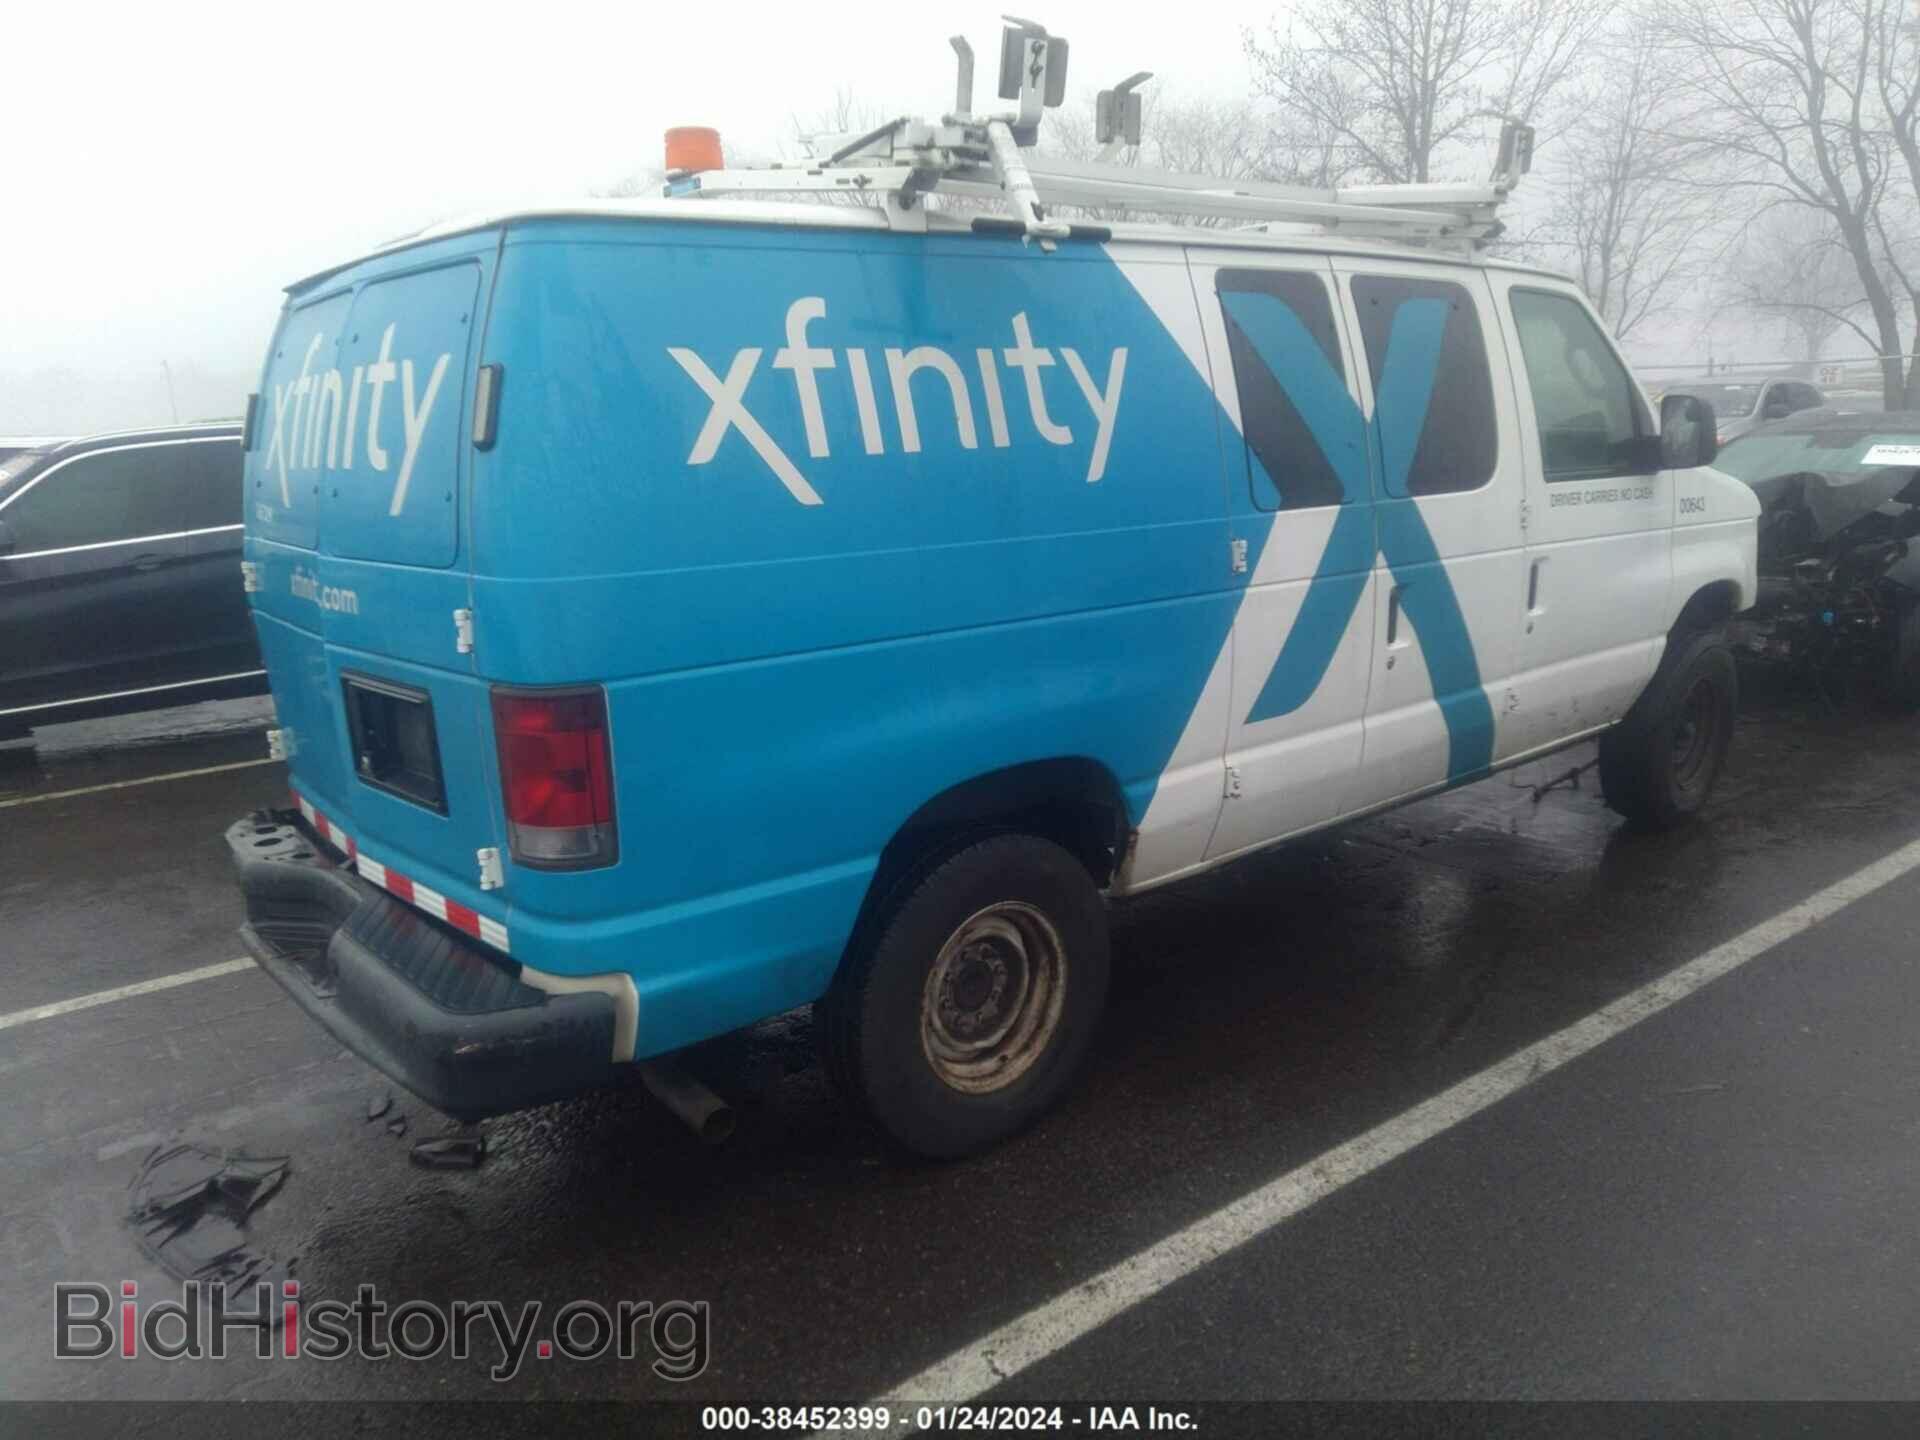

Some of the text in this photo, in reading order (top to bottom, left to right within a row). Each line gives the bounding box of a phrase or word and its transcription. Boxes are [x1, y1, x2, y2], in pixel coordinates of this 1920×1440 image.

[265, 321, 451, 516] xfinity
[666, 297, 1128, 505] xfinity
[1551, 491, 1582, 508] DRIVER
[1584, 487, 1619, 505] CARRIES
[1620, 488, 1633, 502] NO
[1680, 496, 1705, 514] 00643
